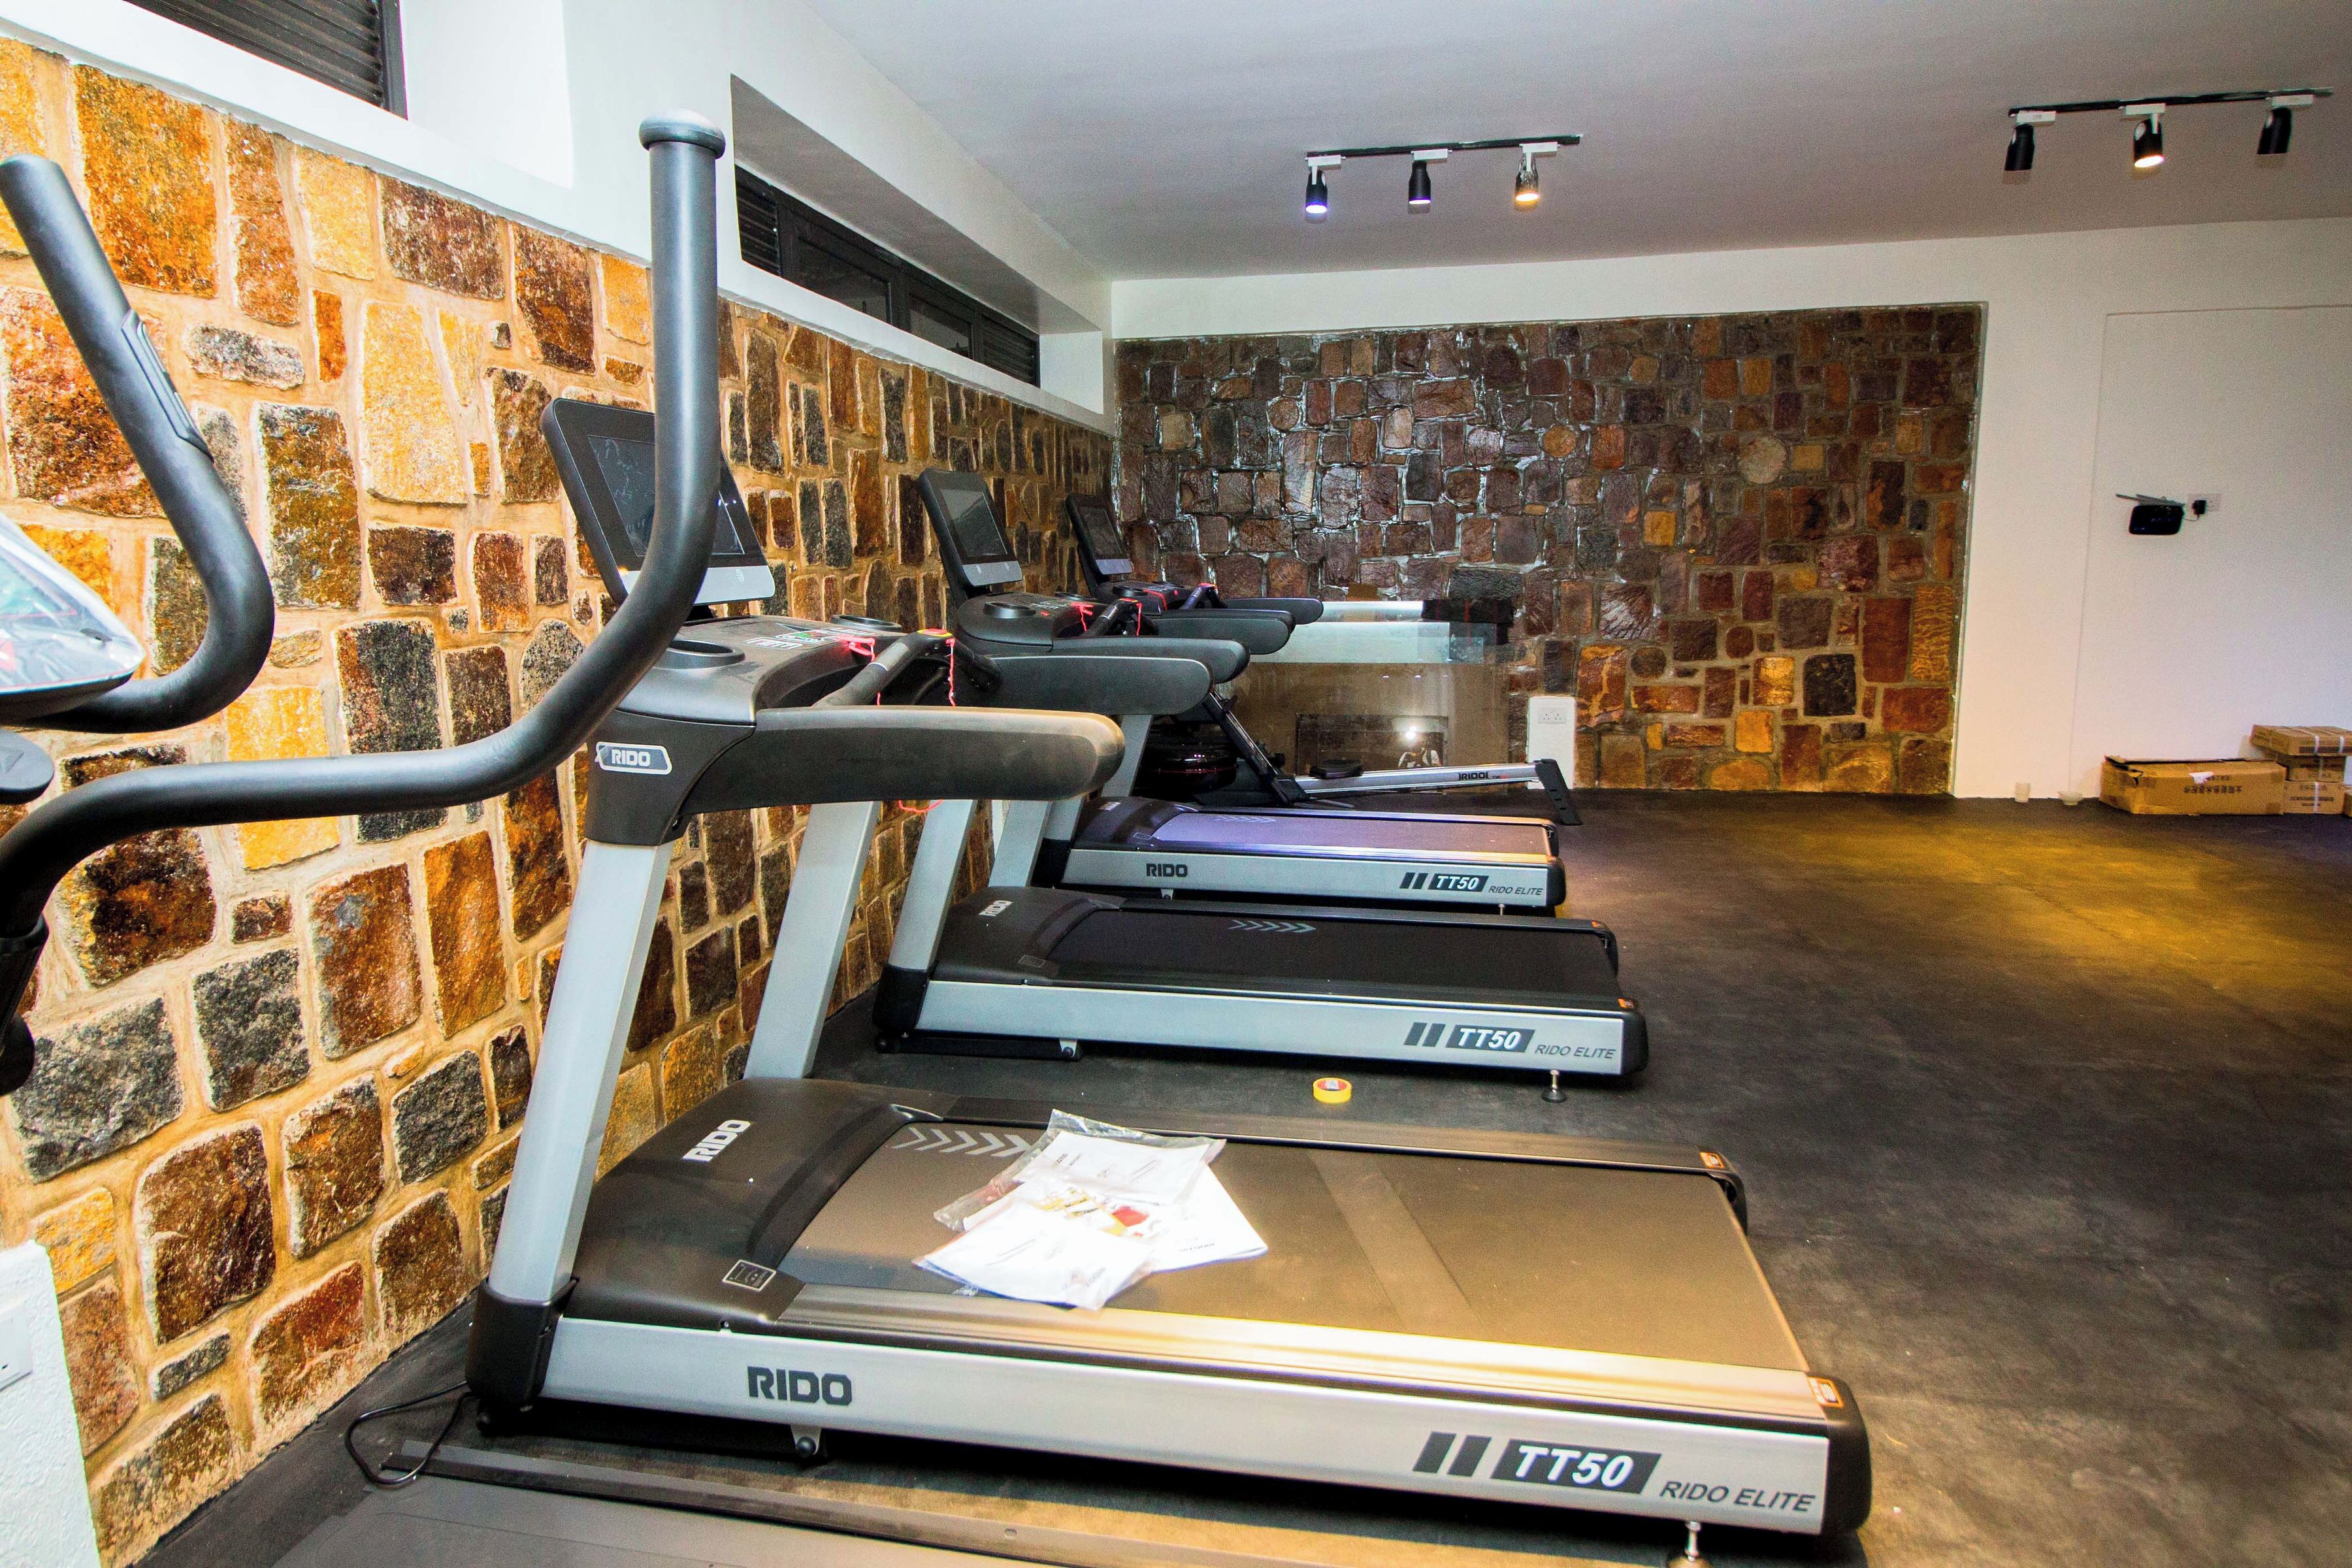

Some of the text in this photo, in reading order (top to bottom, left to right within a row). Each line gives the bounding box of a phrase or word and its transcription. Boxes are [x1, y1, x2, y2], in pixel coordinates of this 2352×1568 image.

[612, 749, 650, 767] RIDO
[1146, 864, 1188, 877] RIDO
[1437, 875, 1543, 895] TT50 RIDO ELITE
[1458, 1028, 1616, 1059] TT50 RIDO ELITE
[682, 1119, 751, 1162] RIDO
[747, 1365, 853, 1405] RIDO
[1515, 1445, 1816, 1512] TT50 RIDO ELITE
